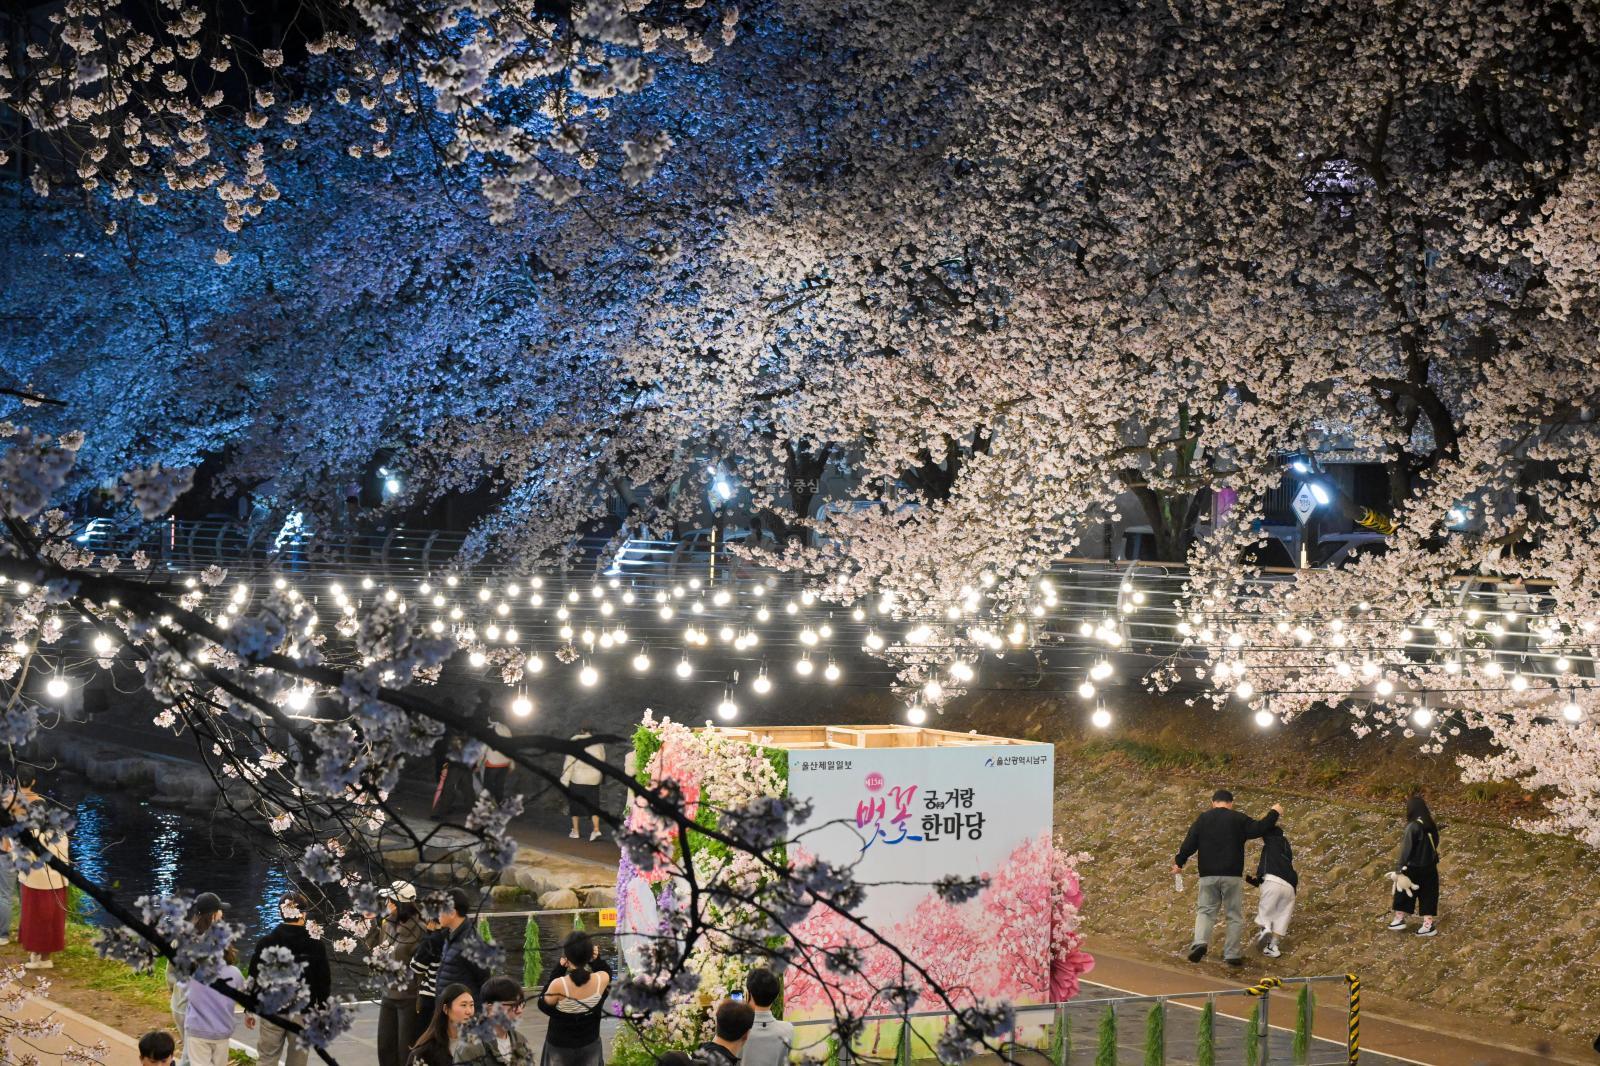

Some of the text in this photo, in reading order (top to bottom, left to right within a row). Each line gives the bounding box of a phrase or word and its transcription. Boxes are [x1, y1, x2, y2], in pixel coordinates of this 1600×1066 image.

[801, 760, 852, 771] 울산제일일보
[996, 755, 1048, 766] 울산광역시남구
[923, 788, 975, 810] 궁거랑
[855, 784, 922, 852] 벚꽃
[921, 812, 986, 842] 한마당
